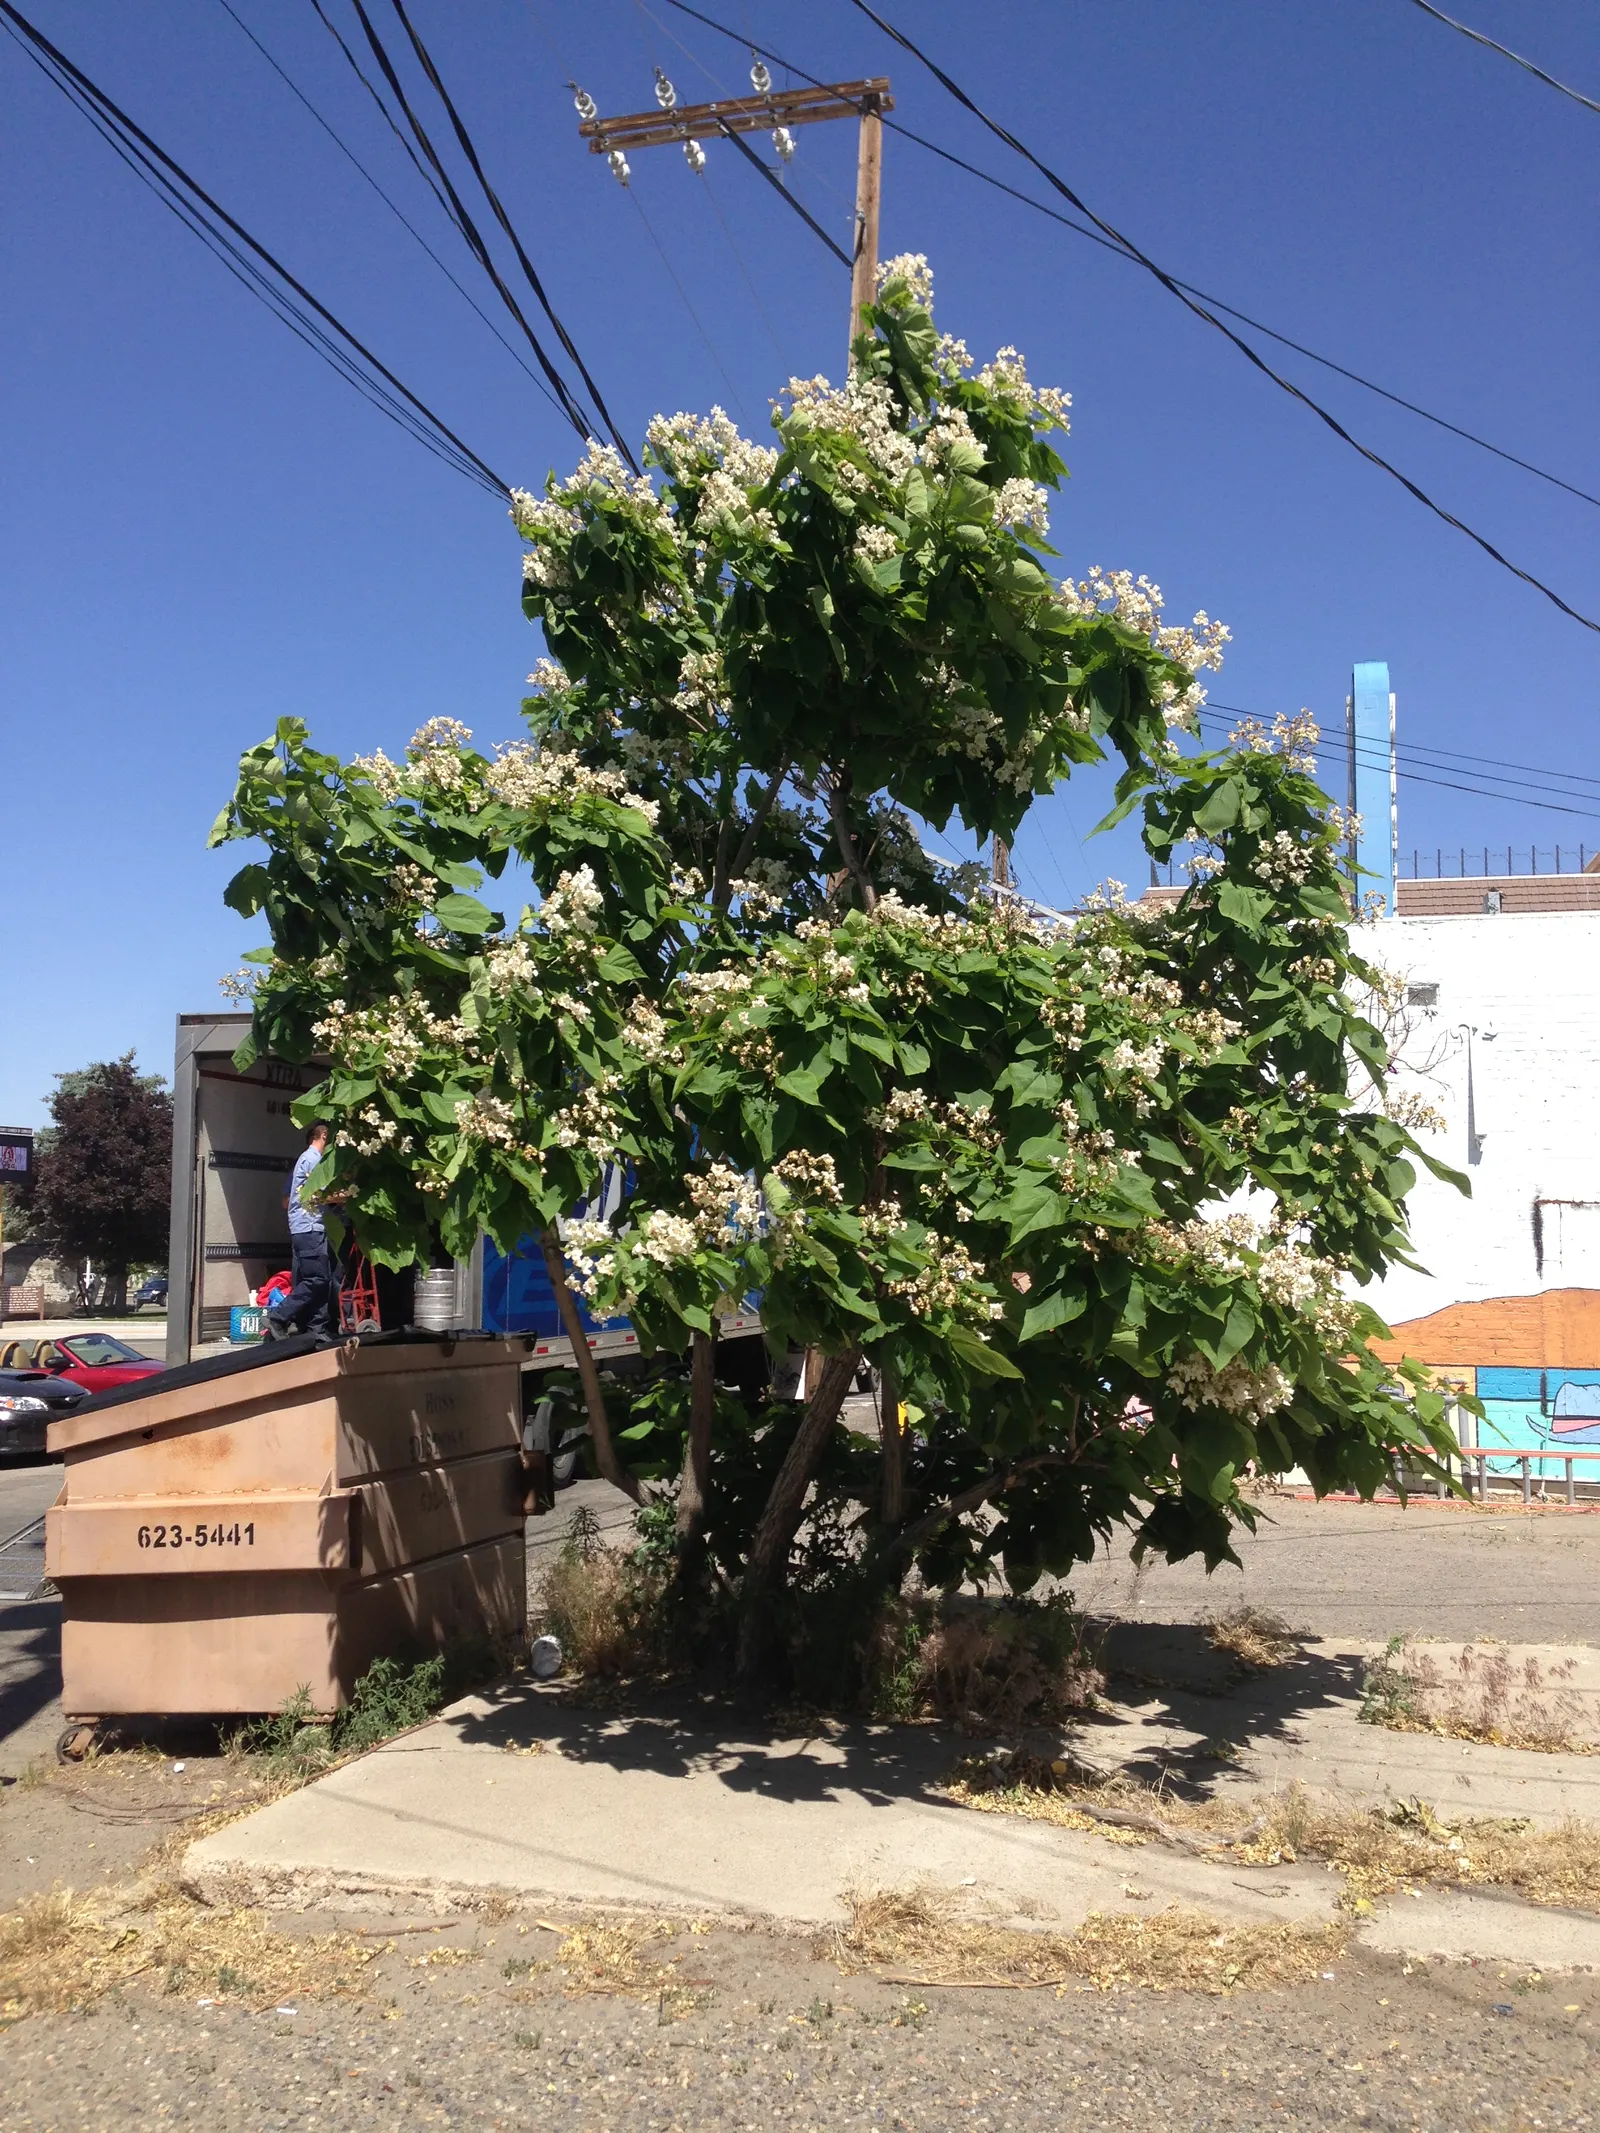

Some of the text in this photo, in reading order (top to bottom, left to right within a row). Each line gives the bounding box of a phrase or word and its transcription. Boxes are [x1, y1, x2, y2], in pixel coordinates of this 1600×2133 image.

[266, 1063, 302, 1088] XTRA
[240, 1316, 259, 1332] FIJI
[137, 1522, 255, 1548] 623-5441
